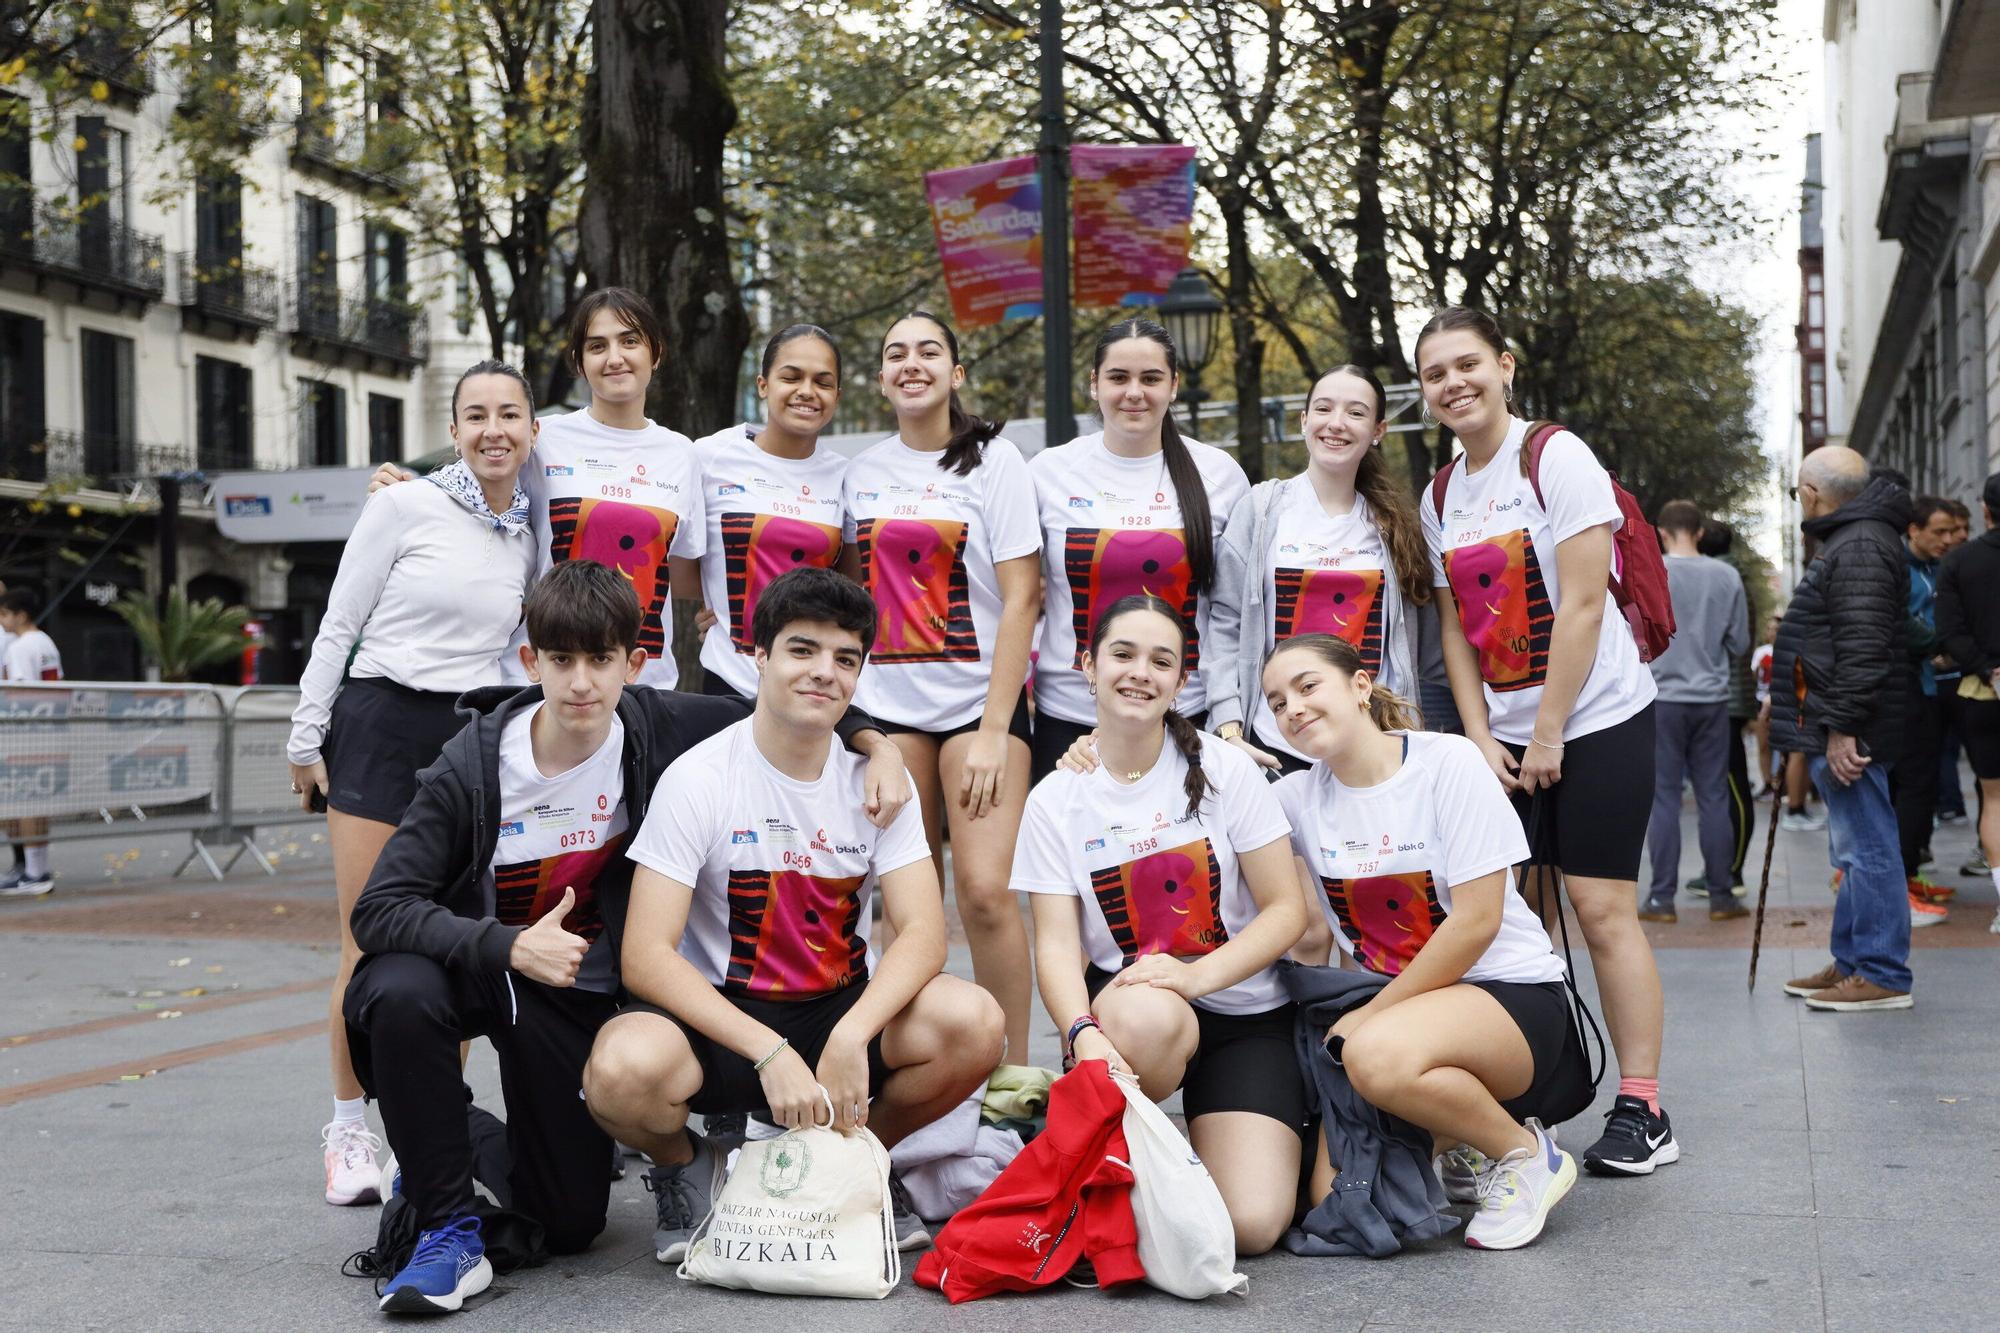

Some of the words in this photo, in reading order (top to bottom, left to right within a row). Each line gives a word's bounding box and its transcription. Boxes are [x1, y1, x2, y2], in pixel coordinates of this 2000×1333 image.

[934, 196, 976, 219] Fair
[940, 209, 1043, 242] Saturday
[549, 467, 569, 476] Deia
[601, 484, 632, 498] 0398
[773, 502, 800, 514] 0399
[893, 505, 918, 515] 0382
[1120, 516, 1151, 525] 1928
[1318, 557, 1341, 567] 7366
[1511, 635, 1529, 653] 10
[560, 830, 596, 847] 0373
[810, 841, 834, 854] Bilbao
[835, 845, 860, 854] bbk
[1129, 837, 1158, 855] 7358
[1398, 843, 1416, 851] bbk
[1357, 861, 1379, 873] 7357
[1199, 929, 1214, 944] 10
[721, 1203, 762, 1218] BATZAR
[766, 1207, 840, 1223] NAGUSIAK
[714, 1220, 753, 1235] JUNTAS
[714, 1237, 837, 1262] BIZKAIA
